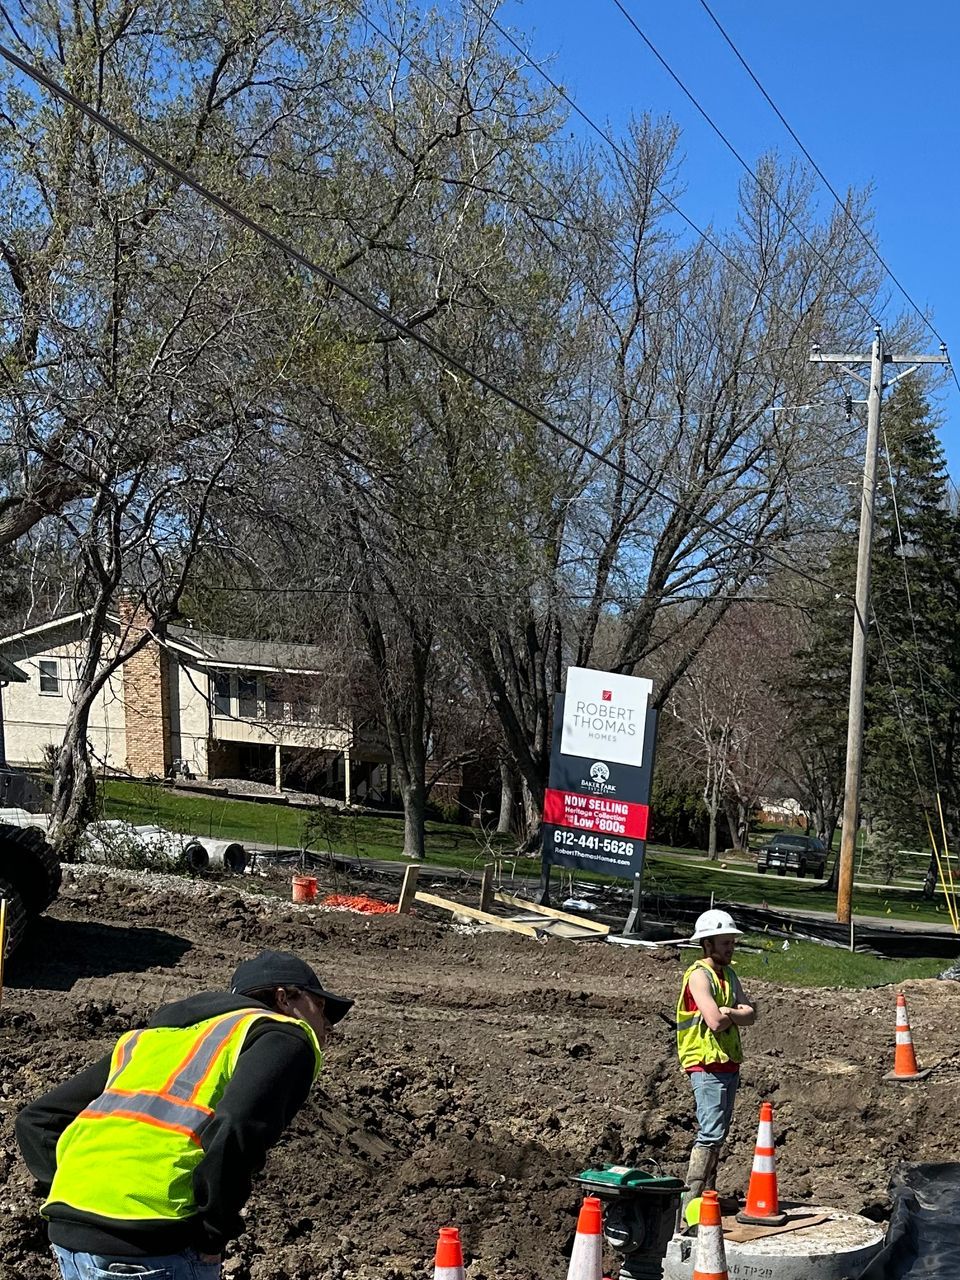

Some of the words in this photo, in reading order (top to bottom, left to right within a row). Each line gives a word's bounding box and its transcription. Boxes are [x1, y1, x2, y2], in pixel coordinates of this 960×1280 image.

[576, 701, 635, 720] ROBERT
[573, 714, 636, 736] THOMAS
[588, 732, 617, 742] HOMES
[581, 779, 600, 788] BAKER
[600, 782, 617, 791] PARK
[564, 795, 587, 808] NOW
[588, 799, 629, 815] SELLING
[565, 806, 592, 817] Heritage
[593, 811, 626, 822] Collection
[595, 817, 626, 834] $800s
[553, 830, 634, 856] 612-441-5626
[554, 847, 631, 866] RobertThomasHomes.com
